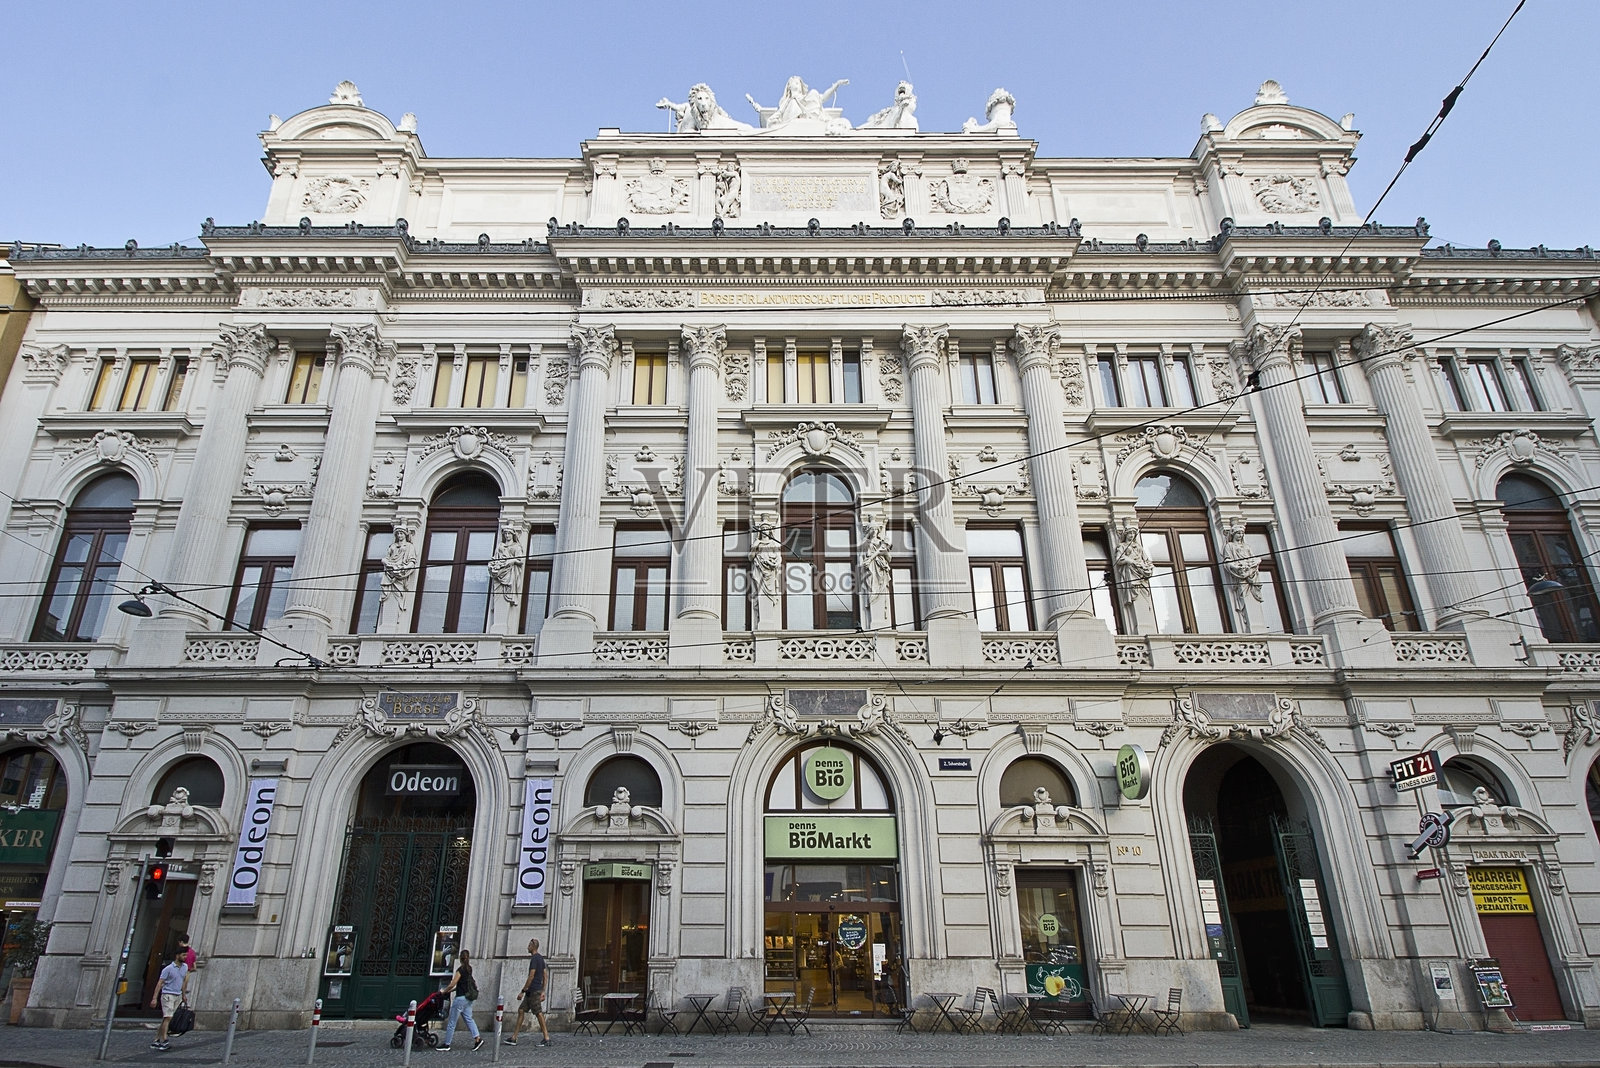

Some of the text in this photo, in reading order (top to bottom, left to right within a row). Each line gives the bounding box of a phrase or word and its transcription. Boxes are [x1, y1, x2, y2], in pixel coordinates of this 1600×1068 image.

[700, 292, 926, 305] BÖRSE FÜR LANDWIRTSCHAFTLICHE PRODUCTE
[393, 702, 440, 714] BÖRSE
[1393, 754, 1434, 780] FIT 21
[391, 771, 458, 791] Odeon
[1122, 777, 1138, 790] Markt
[1398, 774, 1437, 790] FITNESS CLUB
[233, 788, 275, 889] Odeon
[520, 788, 552, 890] Odeon
[1132, 846, 1142, 856] 10
[1474, 850, 1527, 859] TABAK TRAFIK
[1470, 882, 1522, 891] ACHGESCHÄFT
[1483, 896, 1517, 904] IMPORT-
